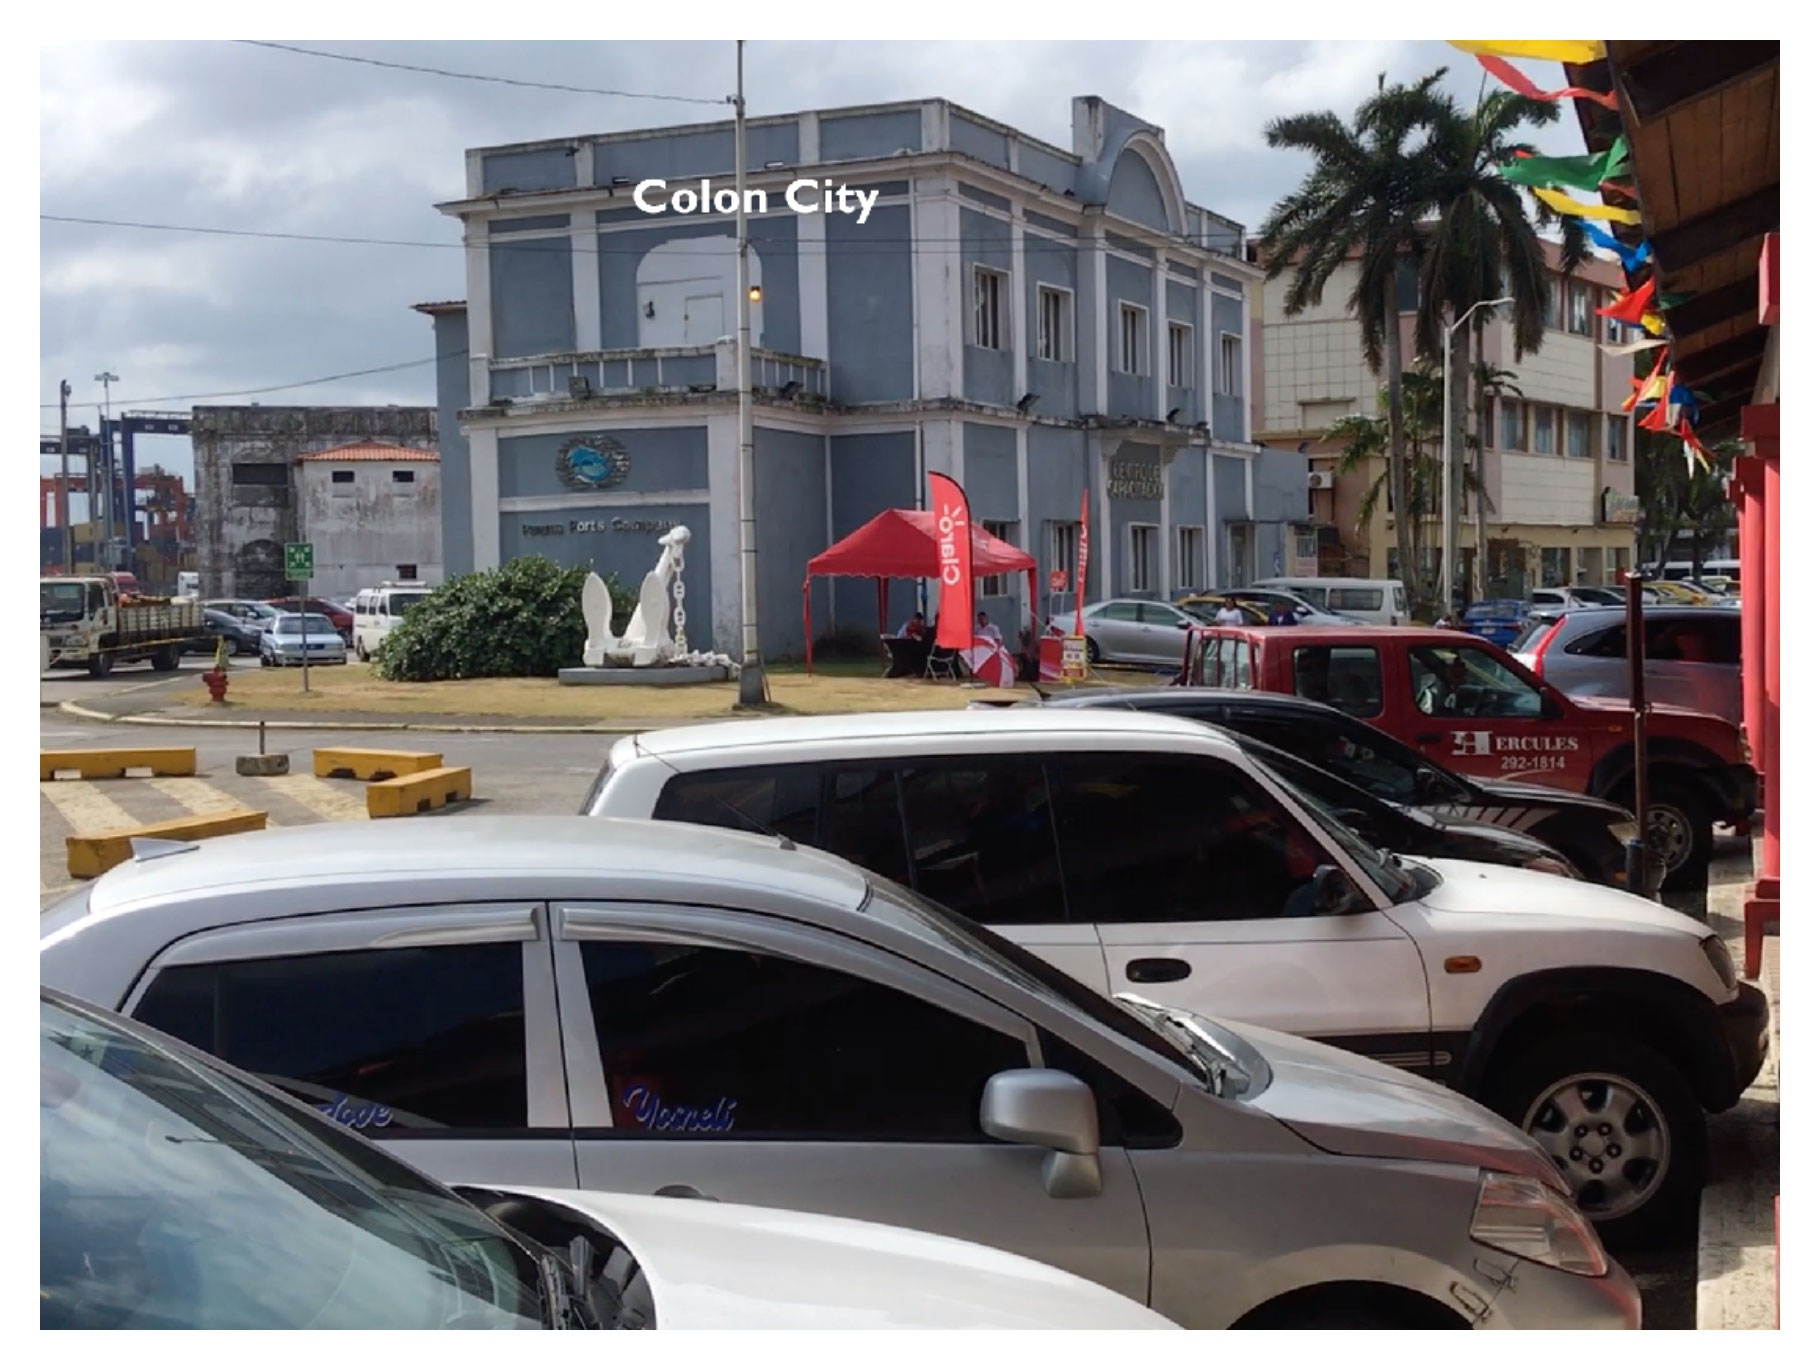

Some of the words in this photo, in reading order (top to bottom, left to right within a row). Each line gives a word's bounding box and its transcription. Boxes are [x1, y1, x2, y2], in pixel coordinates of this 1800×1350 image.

[569, 518, 606, 536] Ports
[939, 513, 960, 586] Claro
[1450, 730, 1579, 756] HERCULES
[1501, 755, 1566, 770] 292-1814
